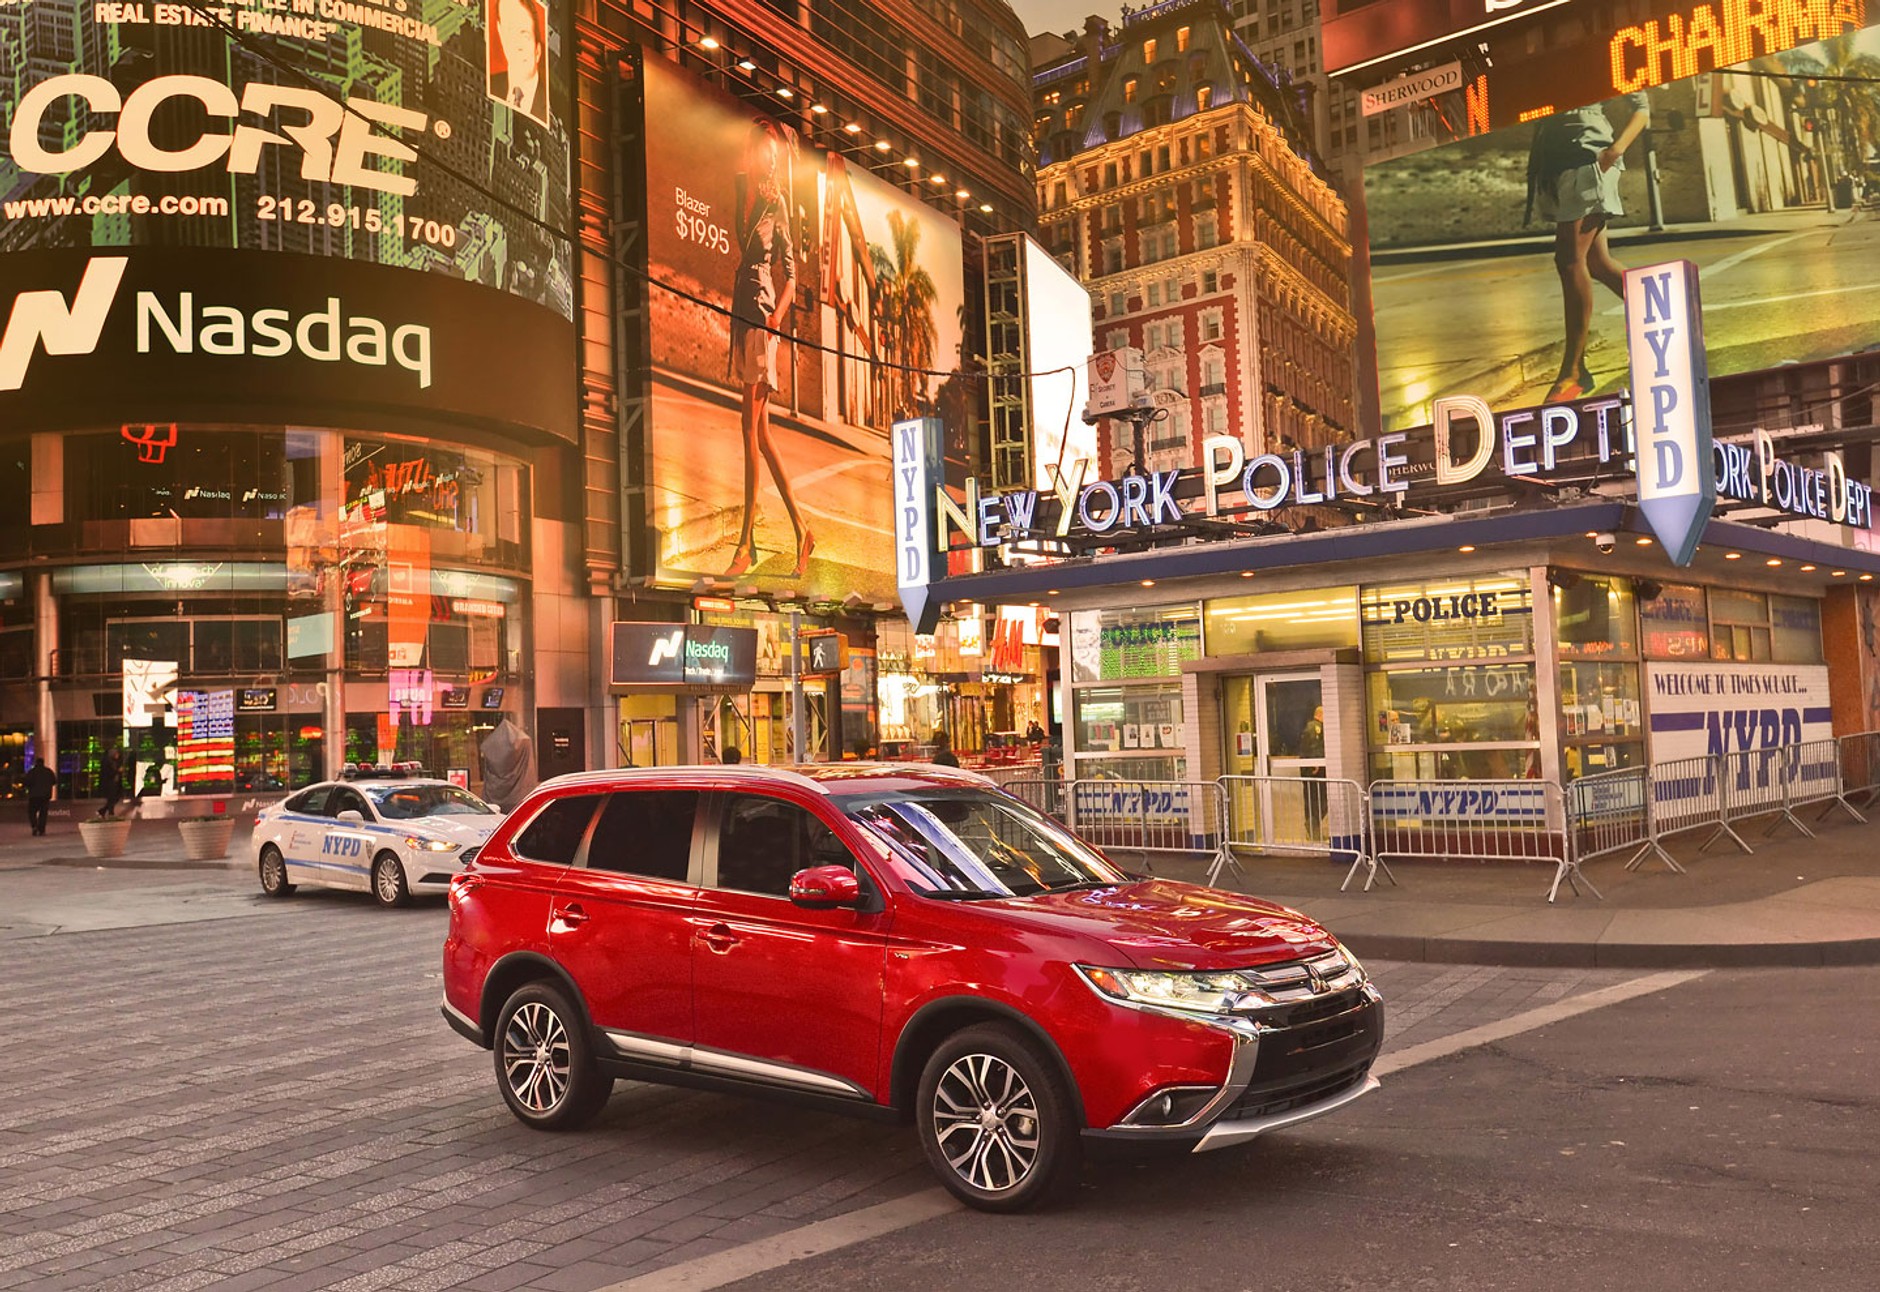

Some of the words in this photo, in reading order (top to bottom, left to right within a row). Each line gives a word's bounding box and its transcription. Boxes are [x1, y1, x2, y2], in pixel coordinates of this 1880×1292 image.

[95, 3, 150, 24] REAL
[154, 4, 234, 29] ESTATE
[319, 0, 442, 47] COMMERCIAL
[1365, 70, 1458, 109] SHERWOOD
[9, 74, 427, 196] CCRE
[4, 195, 228, 219] www.ccre.com
[257, 196, 456, 247] 212.915.1700
[675, 187, 711, 218] Blazer
[675, 209, 730, 256] $19.95
[137, 292, 431, 388] Nasdaq
[1640, 272, 1684, 489] NYPD
[936, 476, 1036, 552] NEW
[1045, 458, 1184, 538] YORK
[1202, 433, 1409, 517] POLICE
[1433, 394, 1622, 486] DEPT
[1754, 428, 1827, 518] POLICE
[1825, 451, 1872, 529] DEPT
[900, 427, 921, 581] NYPD
[1394, 592, 1498, 624] POLICE
[685, 640, 729, 663] Nasdaq
[1655, 674, 1713, 695] WELCOME
[1731, 674, 1761, 695] TIMES
[1704, 708, 1802, 796] NYPD
[1109, 792, 1174, 813] NYPD
[1414, 790, 1499, 815] NYPD
[323, 834, 361, 857] NYPD
